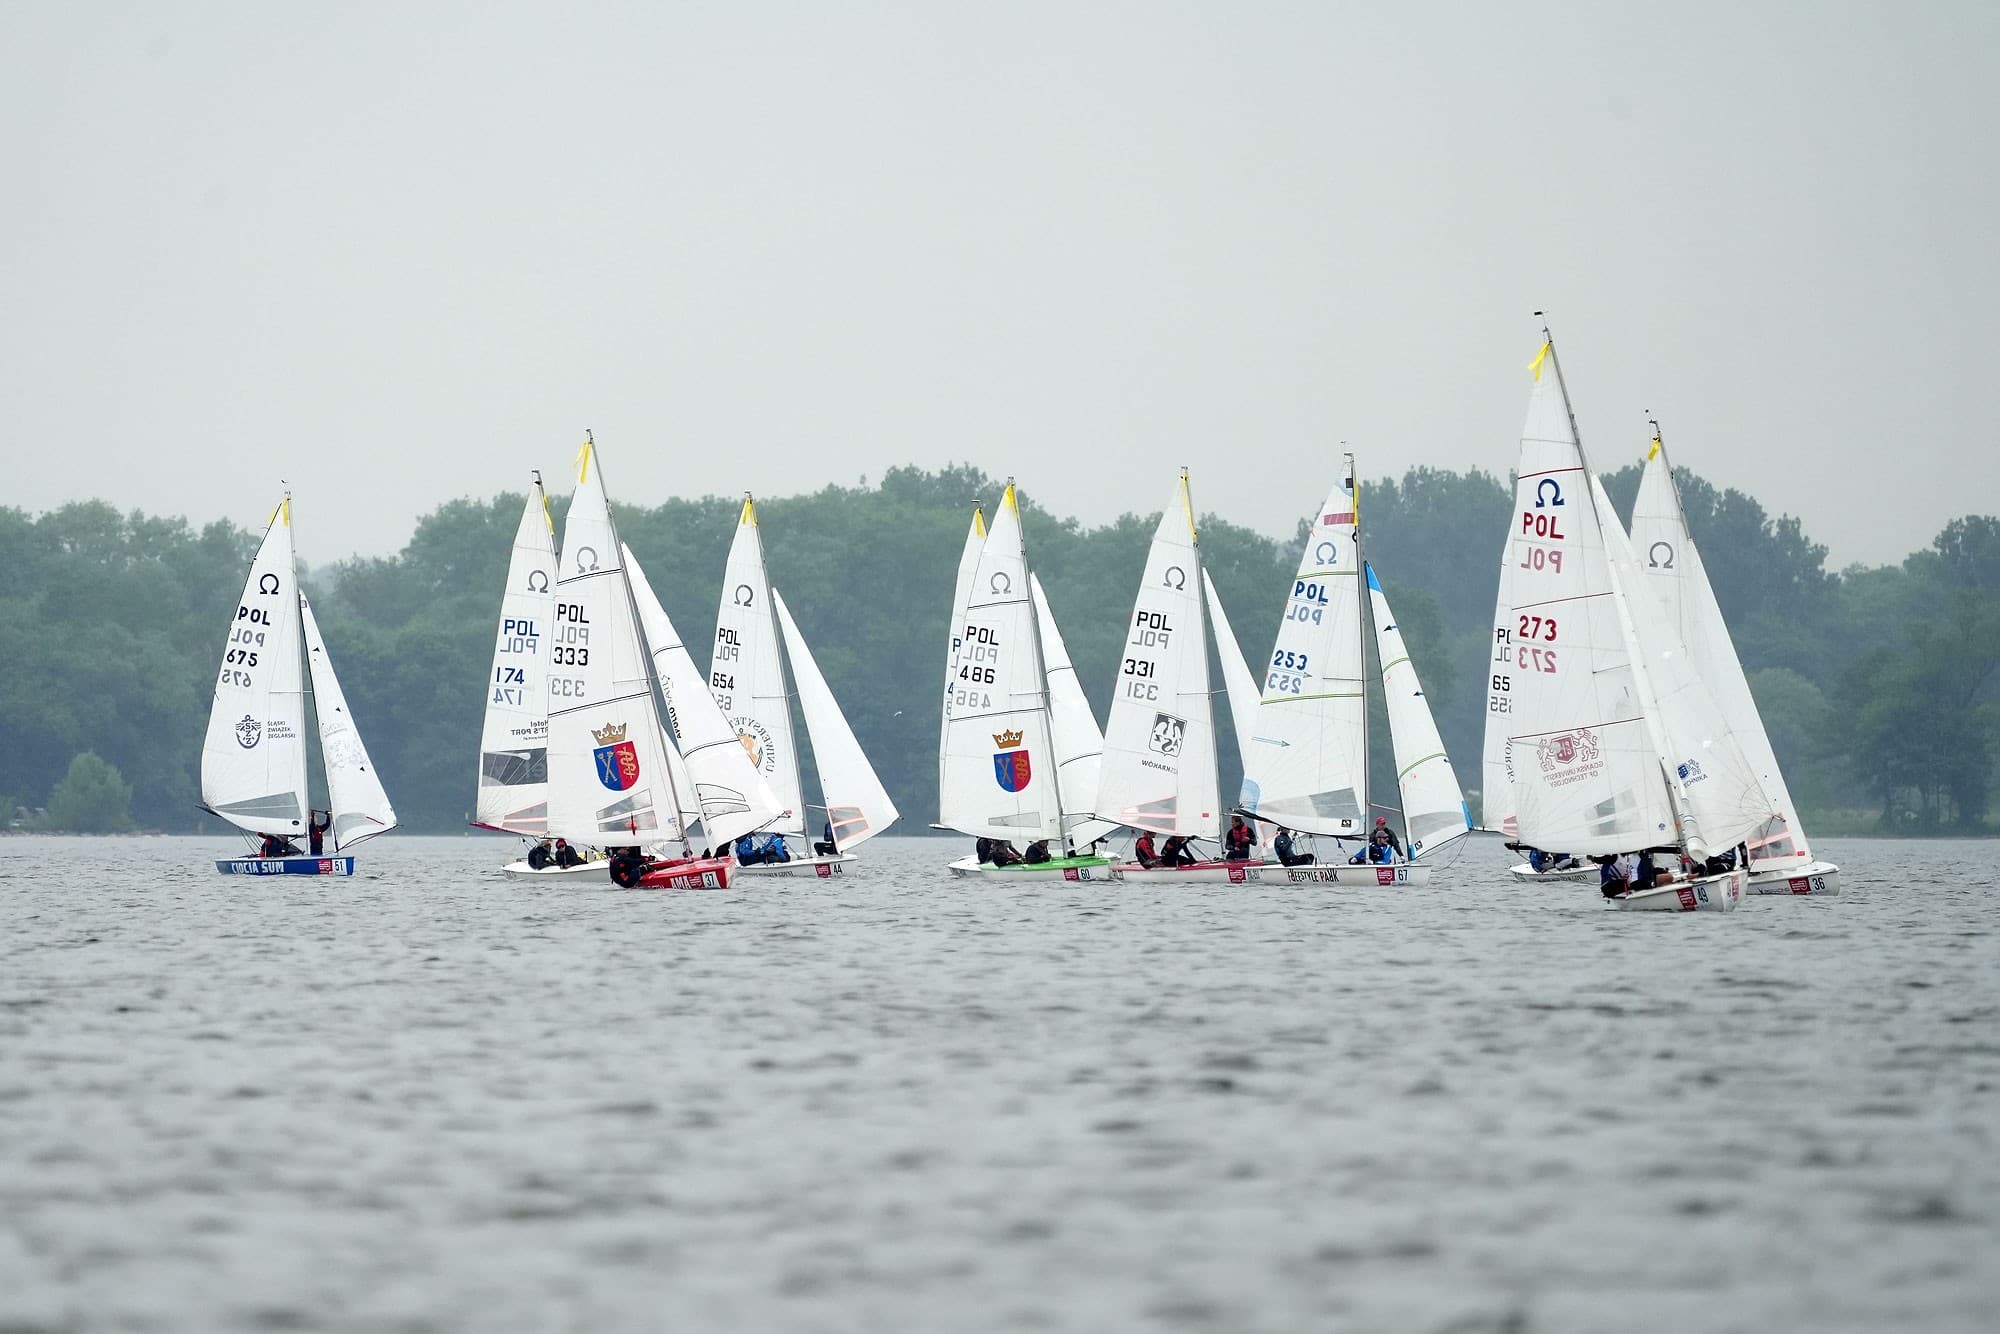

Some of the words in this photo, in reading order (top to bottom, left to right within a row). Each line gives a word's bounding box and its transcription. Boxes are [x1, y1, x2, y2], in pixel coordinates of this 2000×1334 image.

[1523, 512, 1565, 540] POL
[1294, 580, 1329, 603] POL
[238, 606, 270, 626] POL
[557, 603, 590, 624] POL
[1136, 611, 1173, 632] POL
[504, 619, 540, 637] POL
[718, 628, 741, 646] POL
[966, 625, 999, 646] POL
[1519, 615, 1557, 642] 273
[226, 649, 258, 667] 675
[554, 647, 588, 666] 333
[1273, 650, 1308, 671] 253
[496, 666, 525, 684] 174
[960, 665, 996, 684] 486
[1124, 658, 1155, 678] 331
[712, 672, 735, 691] 654
[1493, 675, 1510, 691] 65
[669, 707, 682, 739] APOLLO
[261, 861, 284, 873] SUM
[334, 859, 343, 871] 51
[833, 864, 843, 875] 44
[1398, 869, 1408, 880] 67
[704, 873, 715, 886] 37
[1812, 877, 1825, 890] 36
[1697, 887, 1709, 903] 49
